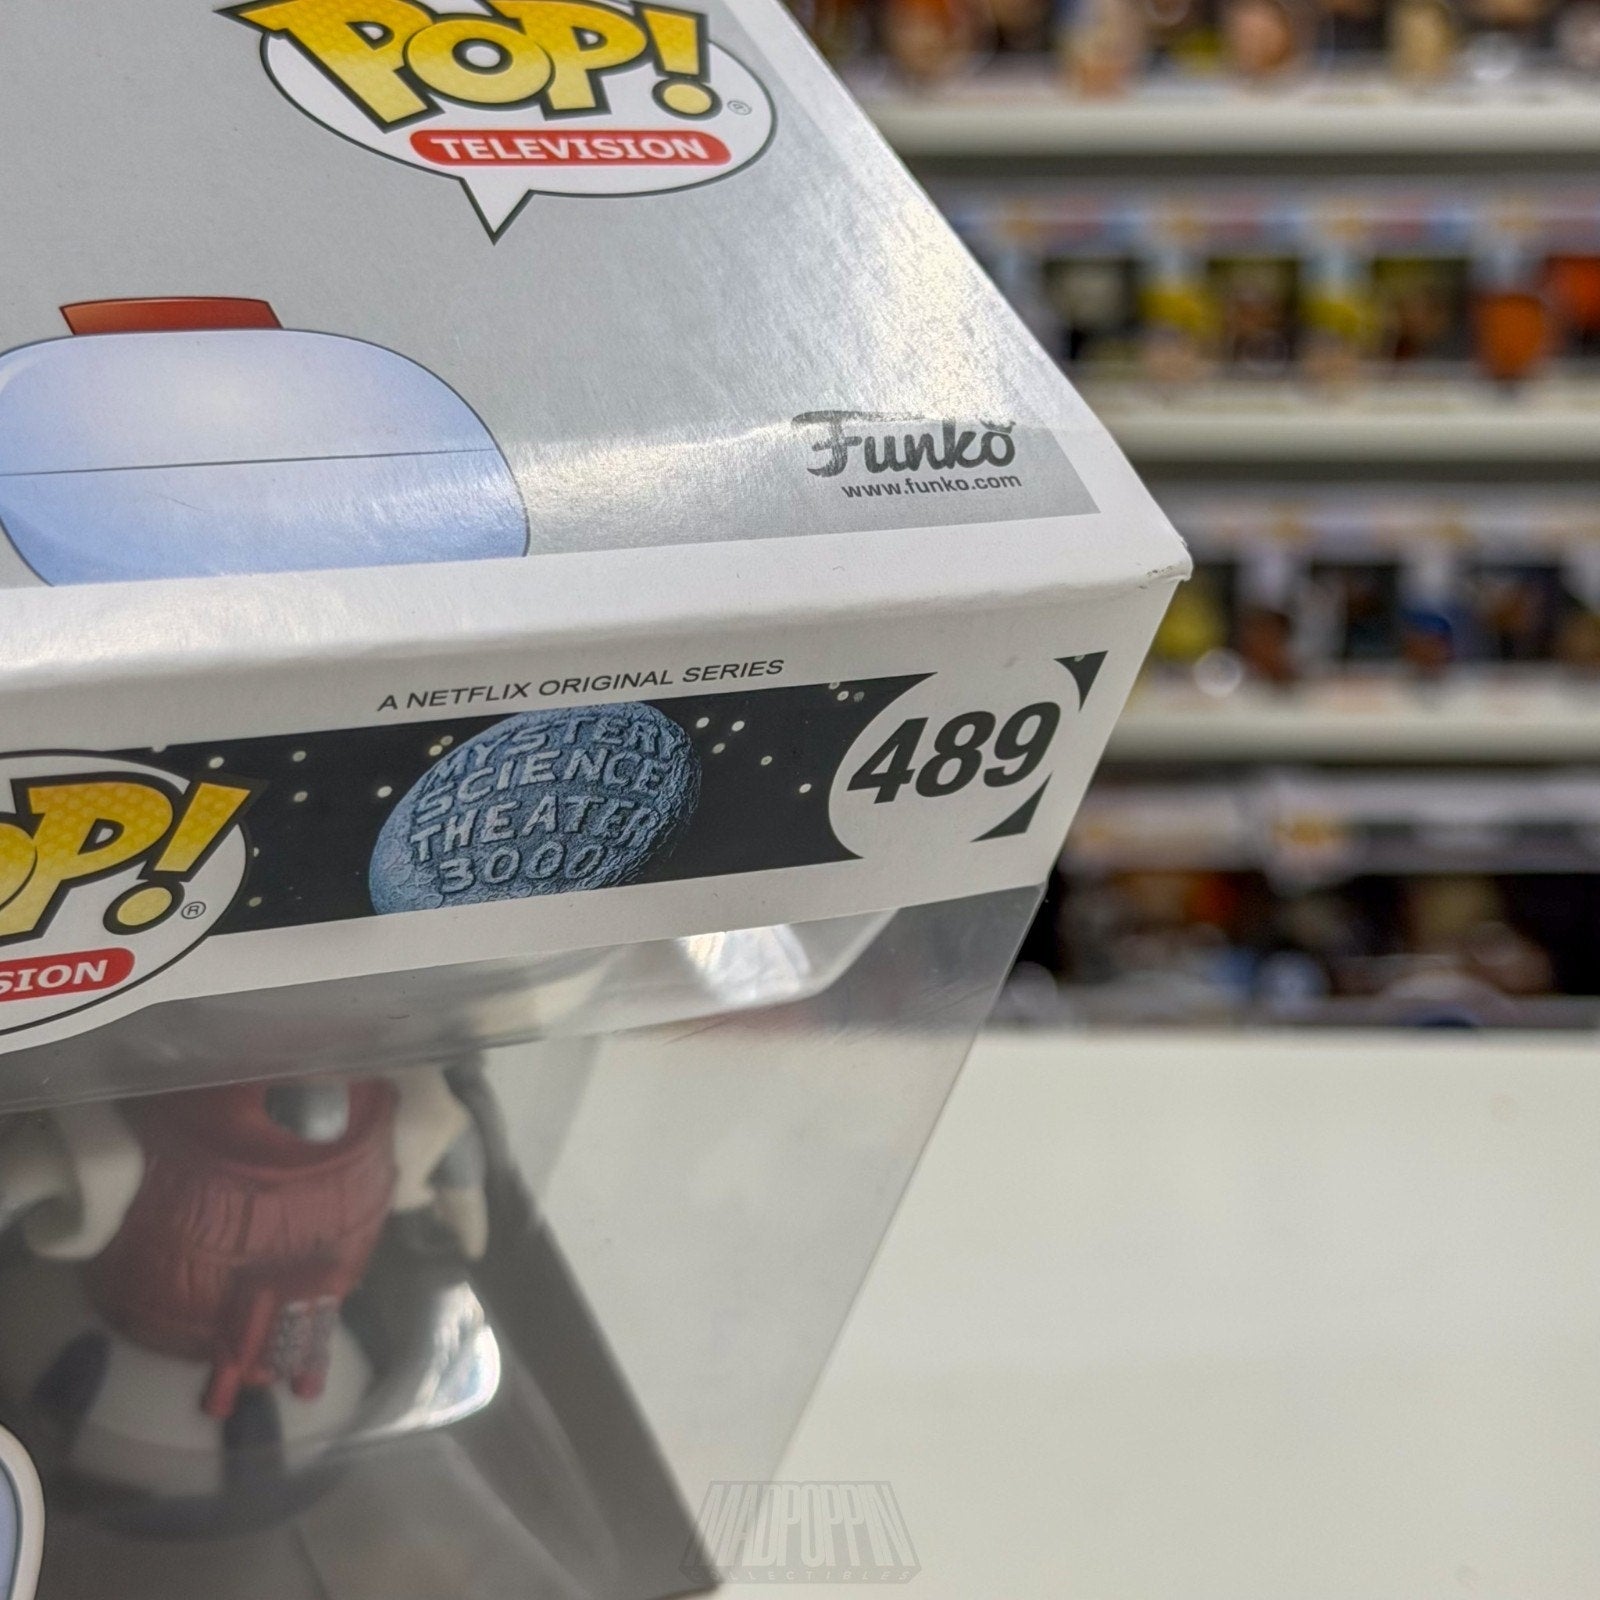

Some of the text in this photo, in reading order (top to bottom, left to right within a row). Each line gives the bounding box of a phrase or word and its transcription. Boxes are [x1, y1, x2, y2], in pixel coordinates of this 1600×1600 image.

[213, 0, 722, 133] POP!
[430, 136, 709, 161] TELEVISION
[792, 410, 1017, 477] Funko
[842, 473, 1023, 498] www.funko.com
[378, 659, 785, 711] A NETFLIX ORIGINAL SERIES
[846, 701, 1061, 804] 489
[416, 748, 664, 825] SCIENCE
[410, 797, 662, 863] THEATER
[439, 840, 606, 893] 3000
